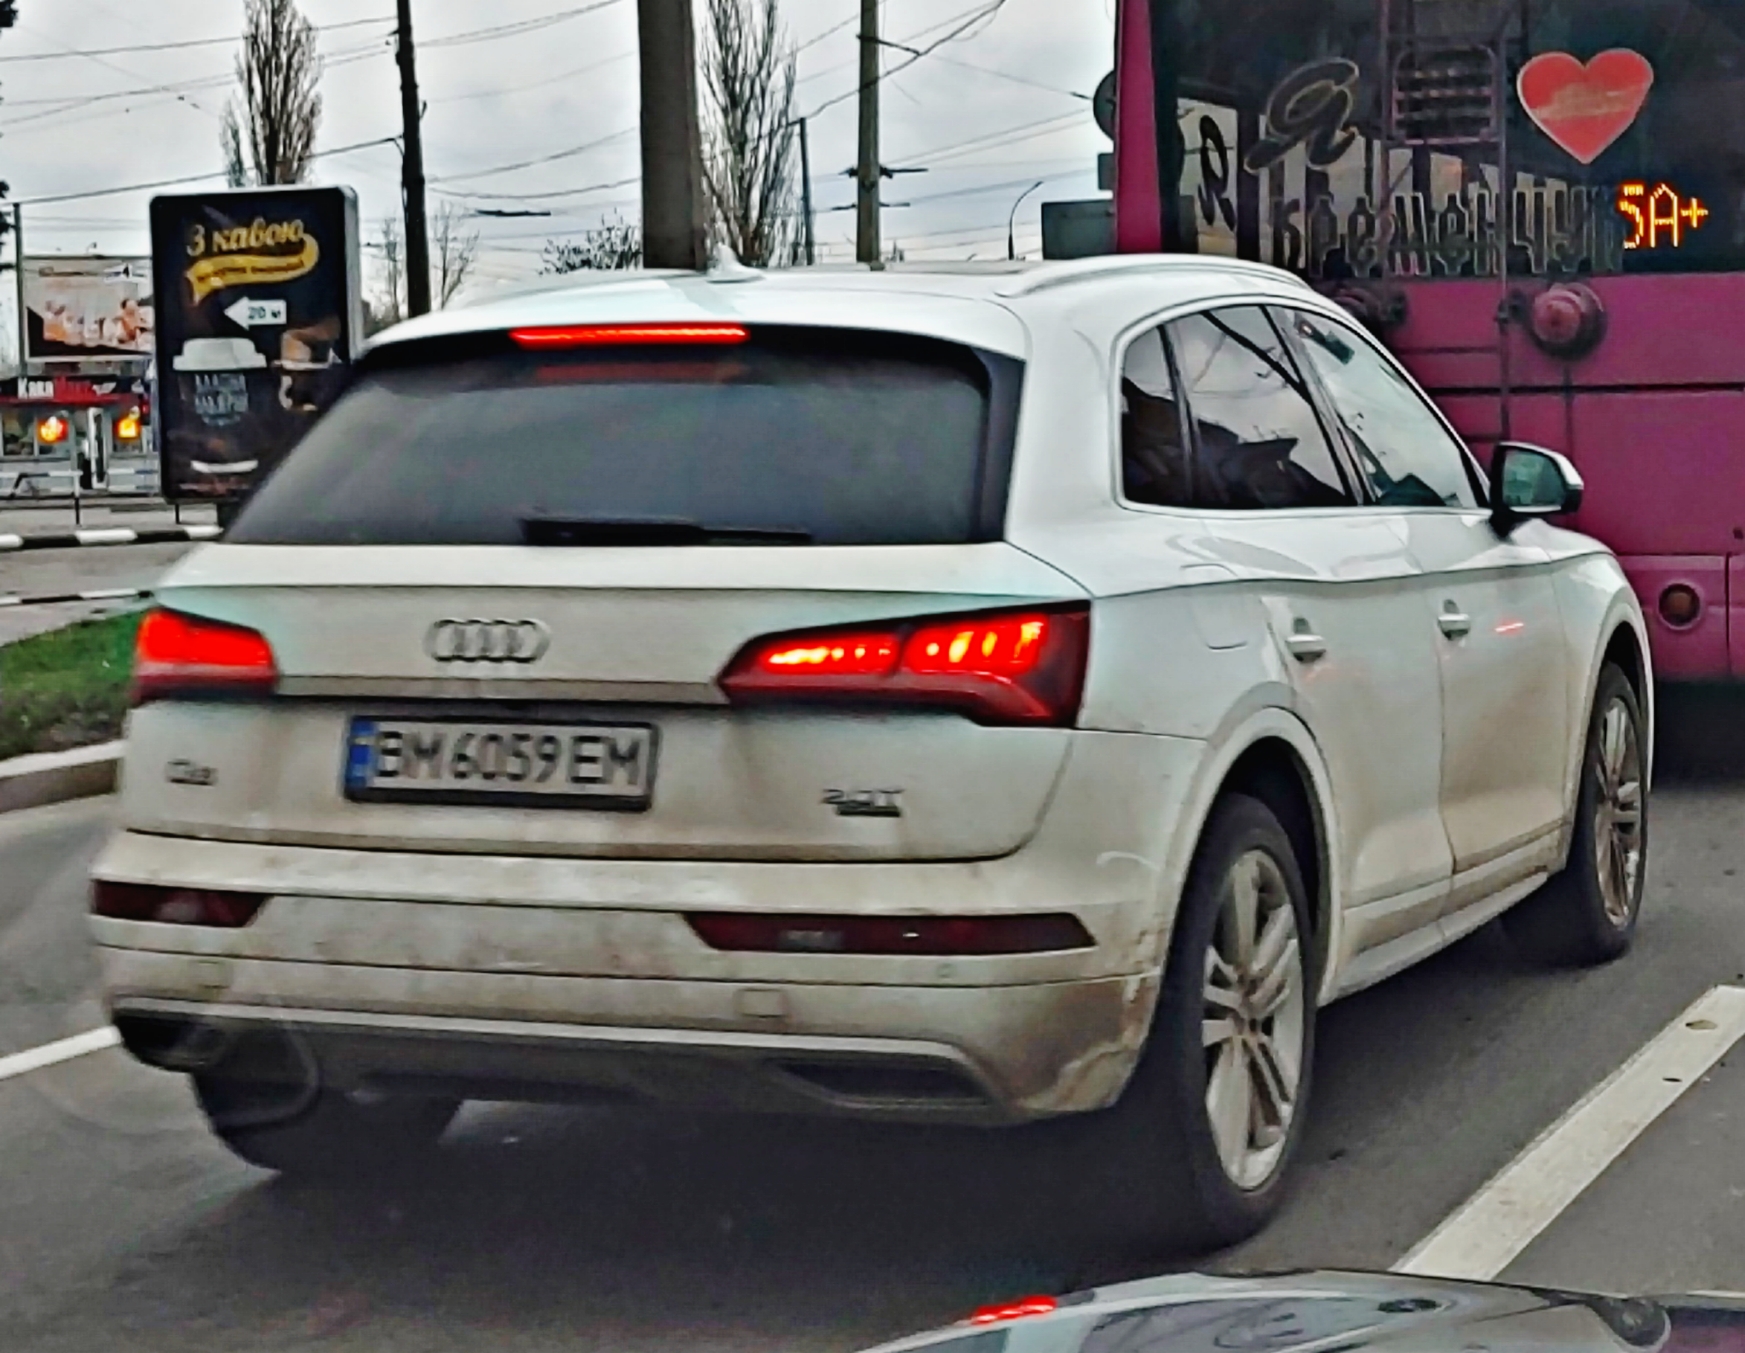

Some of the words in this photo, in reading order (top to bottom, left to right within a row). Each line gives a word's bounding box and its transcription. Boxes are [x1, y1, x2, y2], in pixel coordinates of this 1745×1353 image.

[379, 730, 445, 780] BM
[452, 732, 563, 783] 6059
[569, 735, 641, 785] EM
